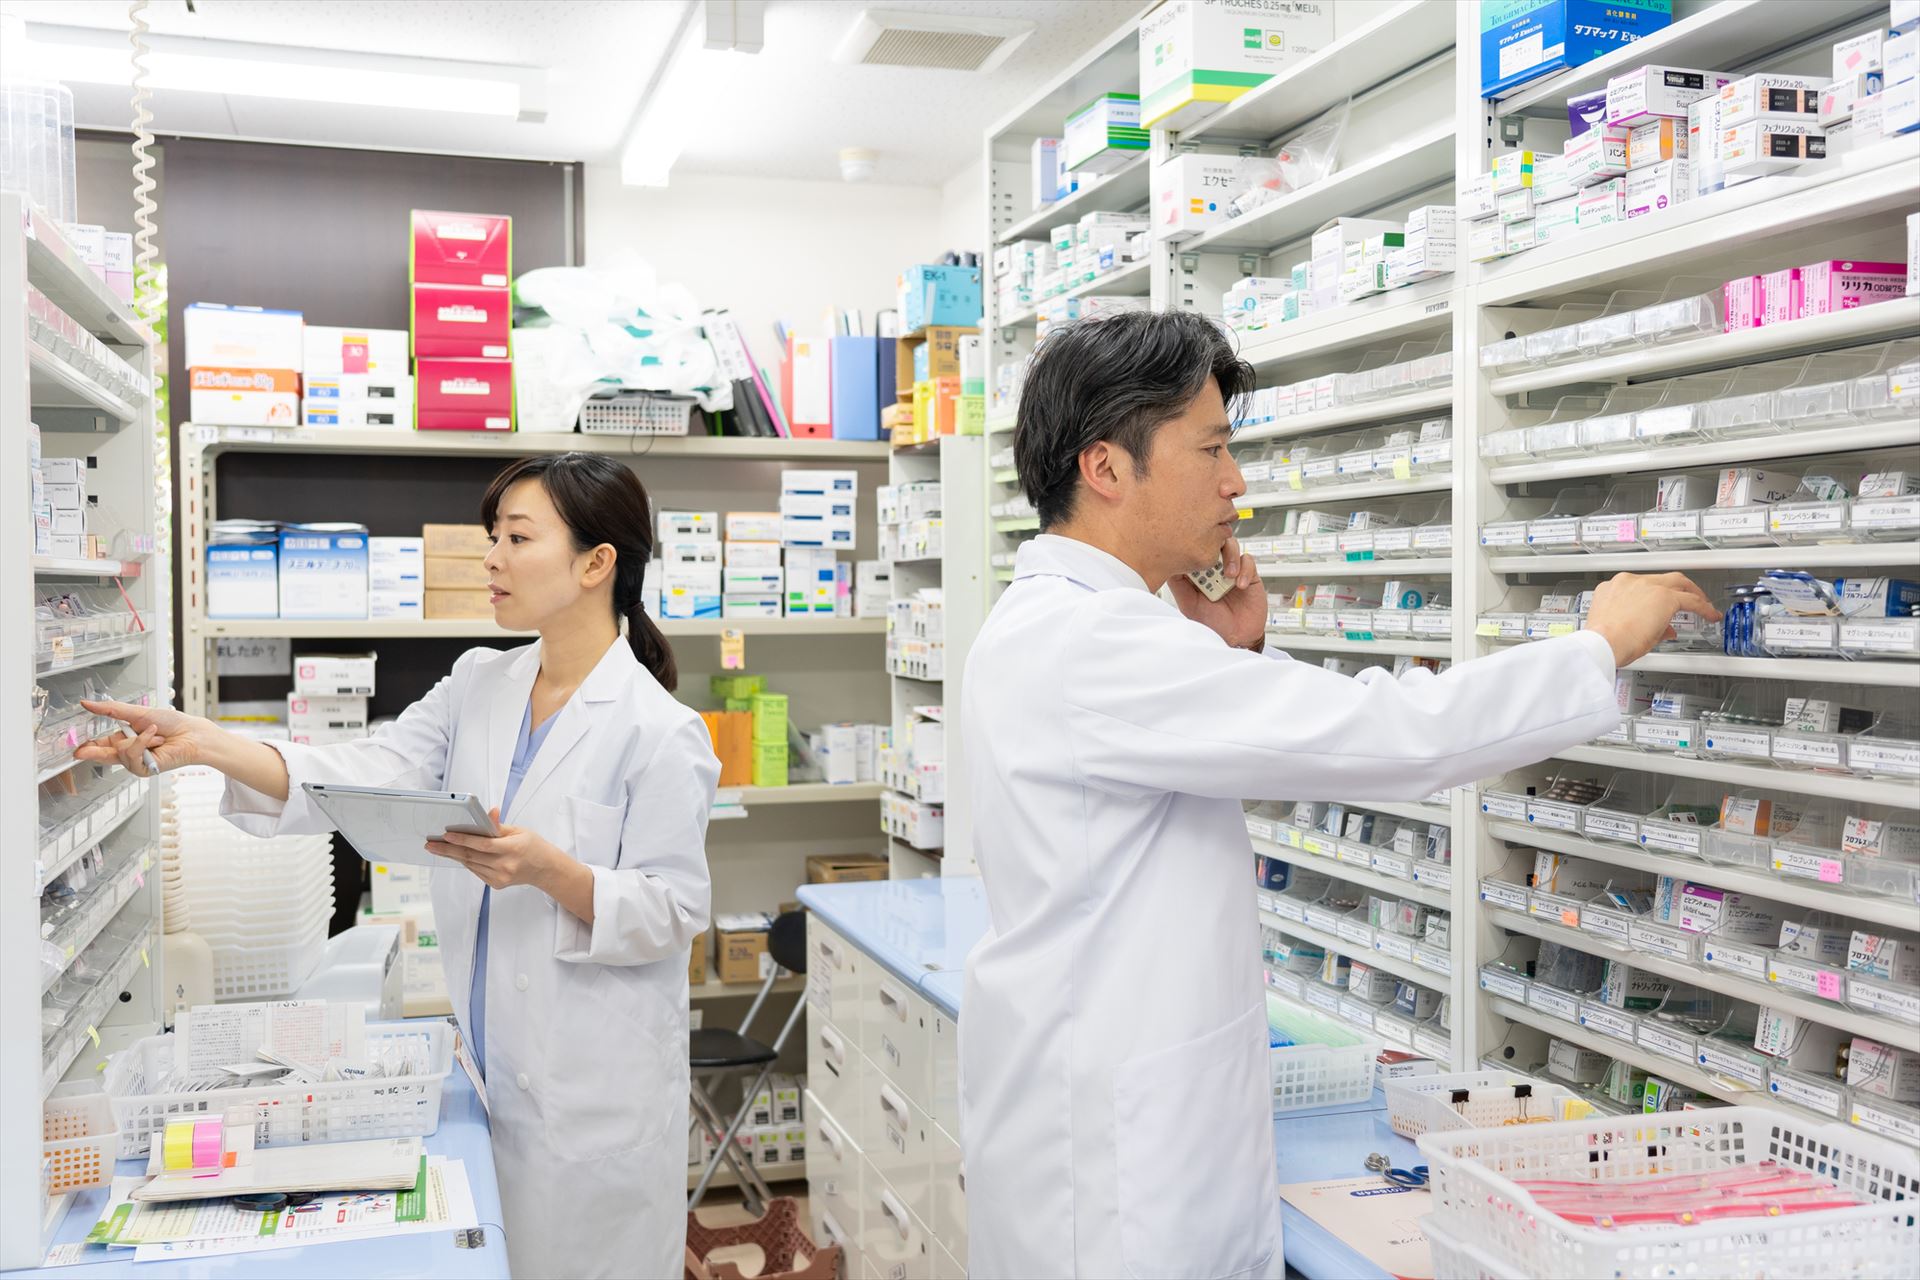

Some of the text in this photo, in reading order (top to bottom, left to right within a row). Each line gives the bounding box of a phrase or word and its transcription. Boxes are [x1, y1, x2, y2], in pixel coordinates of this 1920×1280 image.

[1219, 0, 1262, 9] TROCHES
[1574, 24, 1618, 39] タフマック
[1841, 281, 1873, 292] リリカ
